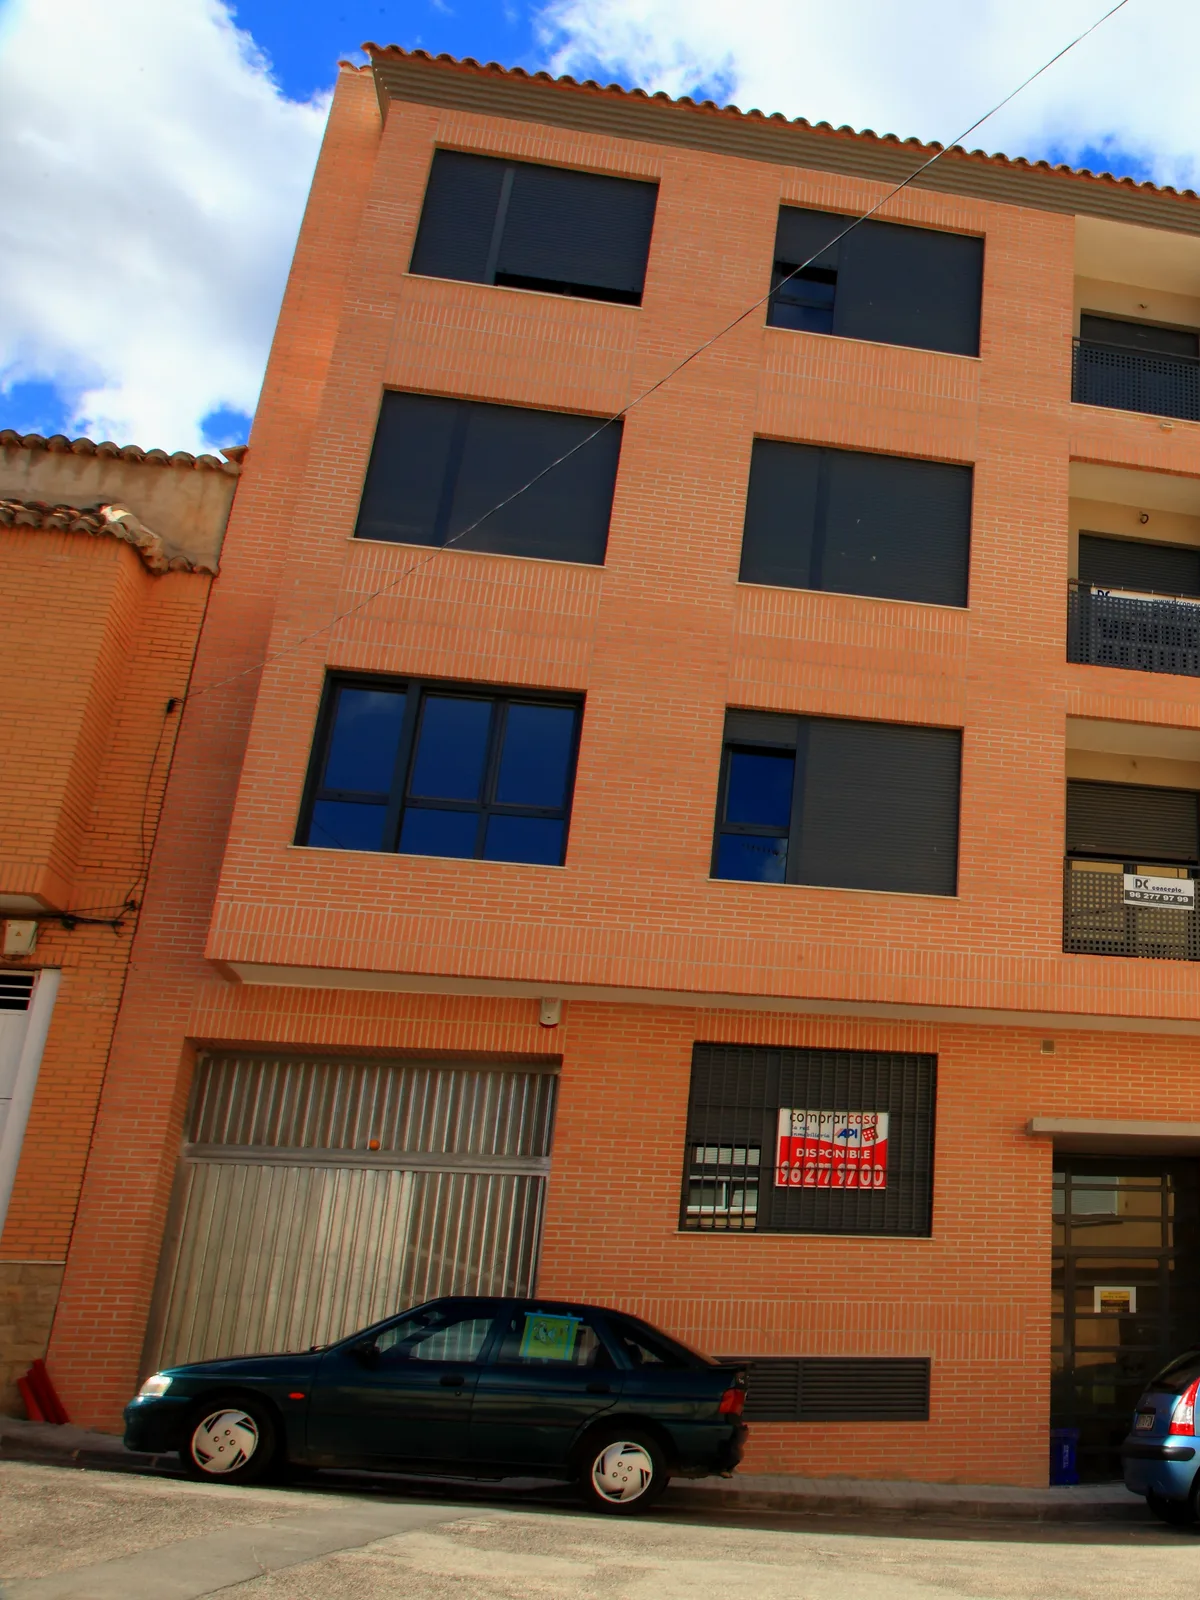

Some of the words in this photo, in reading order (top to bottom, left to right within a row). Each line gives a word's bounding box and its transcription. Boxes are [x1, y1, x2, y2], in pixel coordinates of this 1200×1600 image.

[1135, 878, 1149, 890] DC
[1152, 885, 1182, 893] concepto
[790, 1112, 879, 1127] comprarcasa
[837, 1128, 858, 1139] API
[796, 1148, 871, 1159] DISPONIBLE
[780, 1160, 801, 1183] 96
[804, 1161, 832, 1184] 277
[837, 1163, 857, 1185] 97
[860, 1163, 884, 1186] 00
